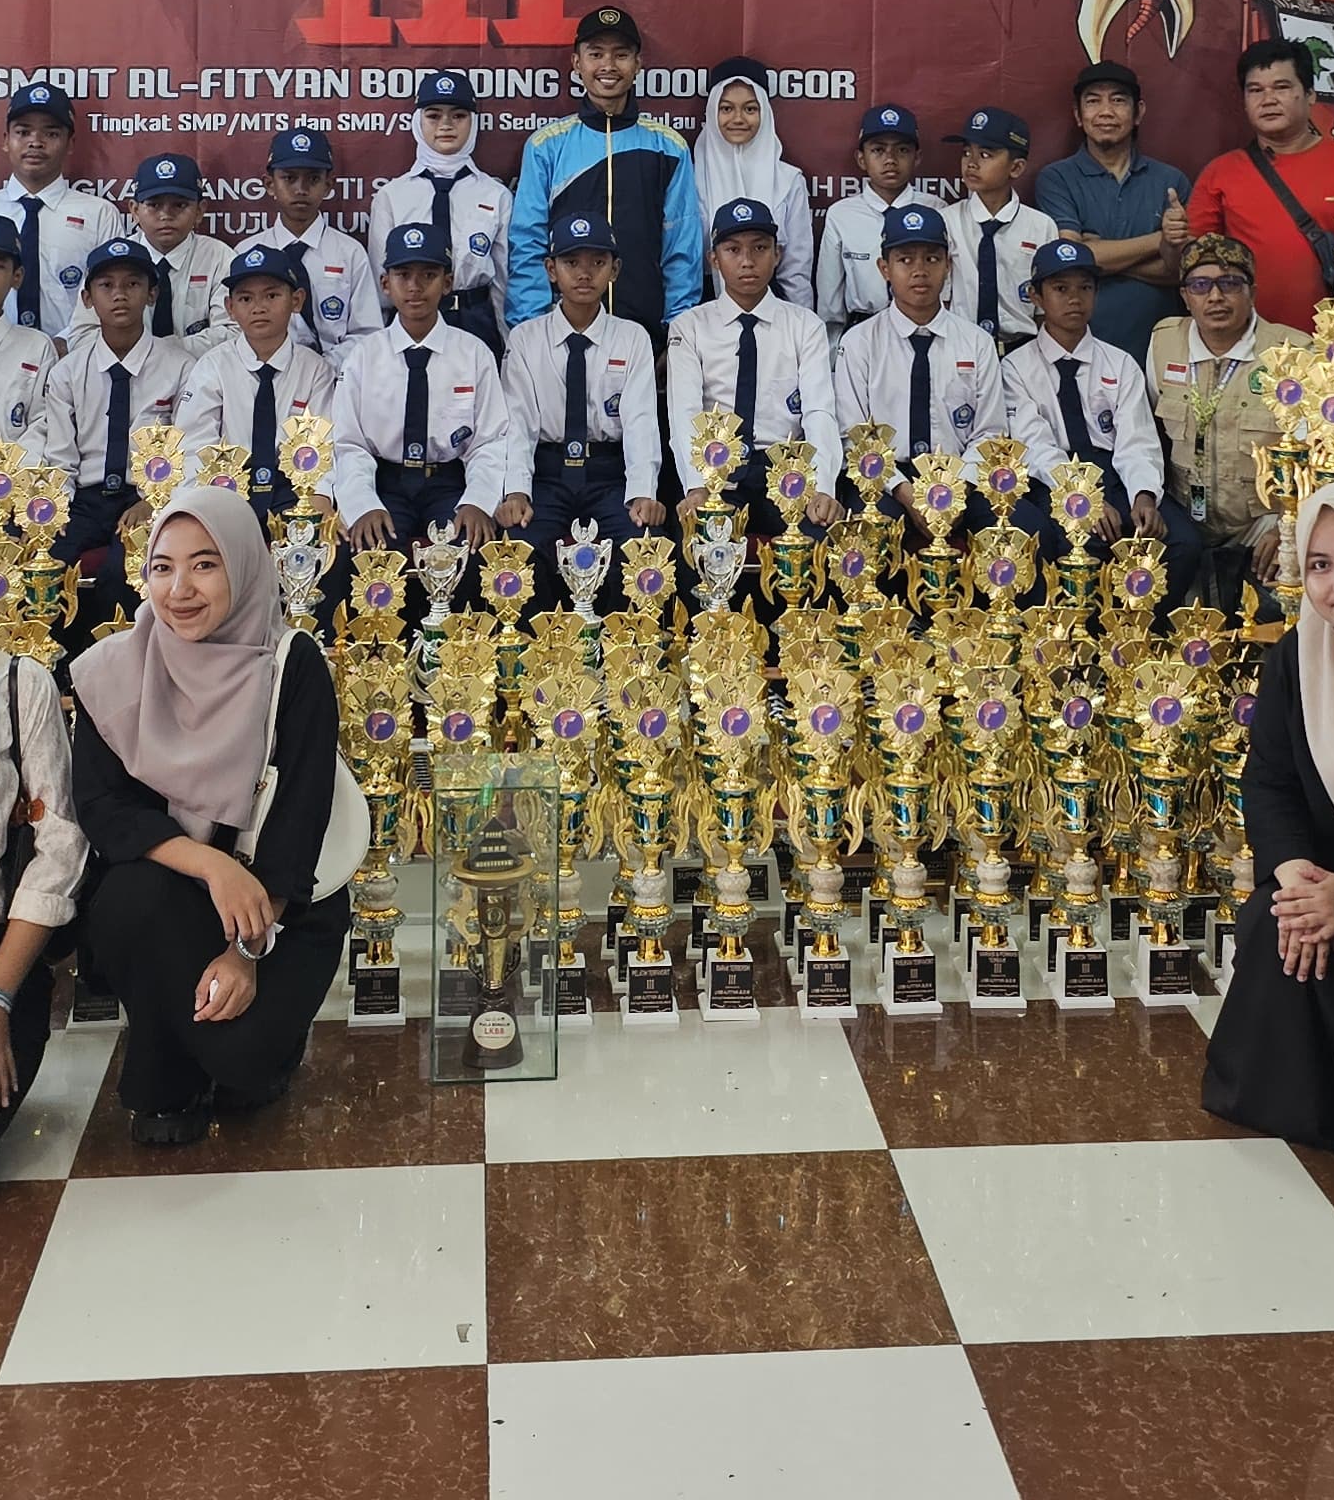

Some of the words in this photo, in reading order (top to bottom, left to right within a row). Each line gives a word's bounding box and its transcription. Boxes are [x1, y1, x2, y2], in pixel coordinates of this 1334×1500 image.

[128, 67, 350, 100] AL-FITYAN
[87, 113, 172, 137] Tingkat
[177, 113, 289, 137] SMP/MTS
